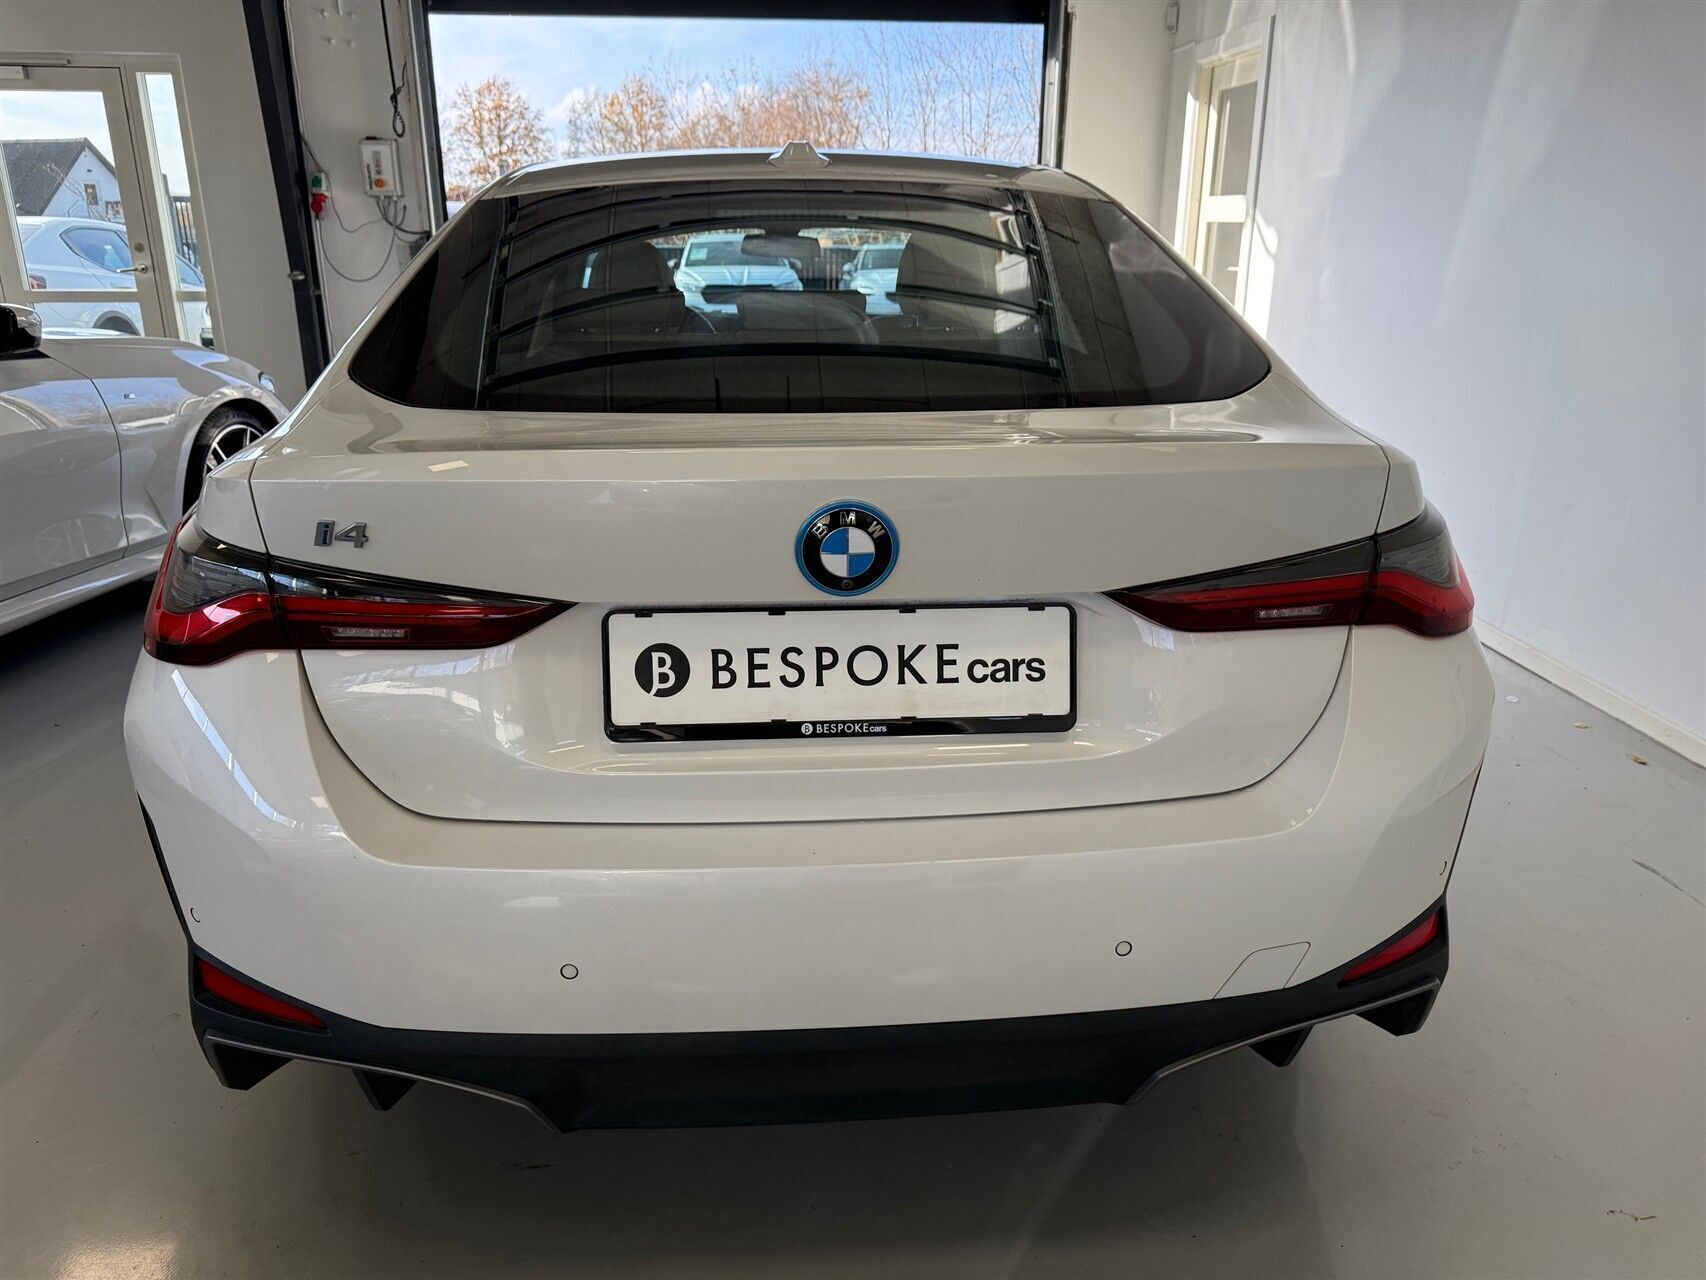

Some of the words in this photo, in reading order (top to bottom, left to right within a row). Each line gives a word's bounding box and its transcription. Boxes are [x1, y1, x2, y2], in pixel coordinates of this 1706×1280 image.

[314, 519, 369, 548] i4
[811, 511, 886, 539] BMW
[710, 643, 960, 690] BESPOKE
[966, 657, 1047, 684] cars
